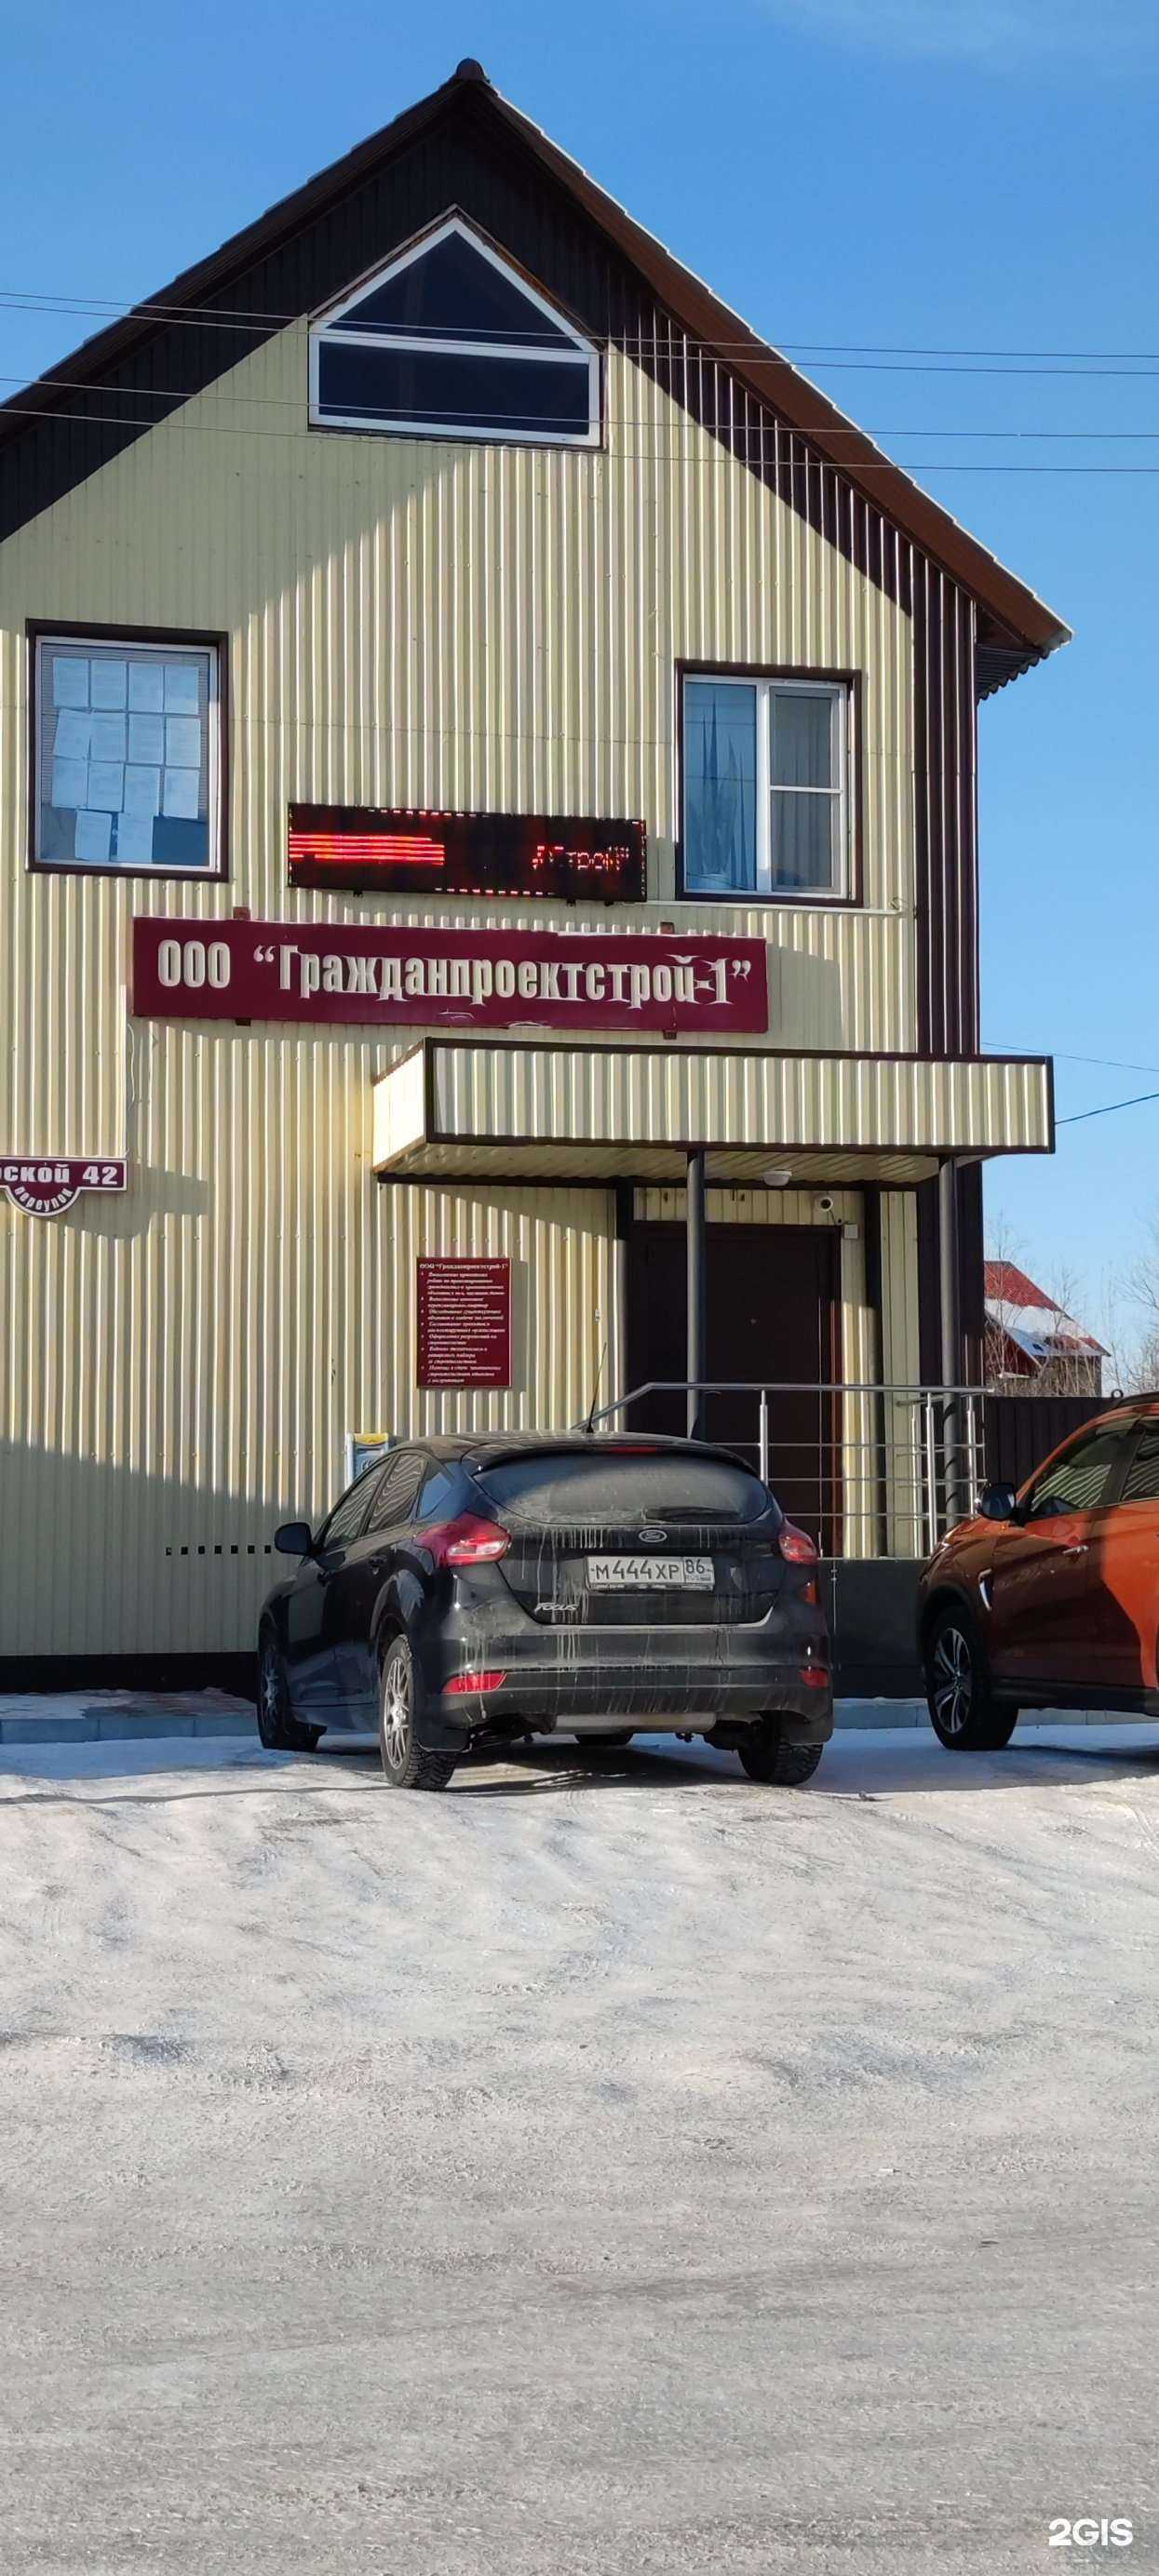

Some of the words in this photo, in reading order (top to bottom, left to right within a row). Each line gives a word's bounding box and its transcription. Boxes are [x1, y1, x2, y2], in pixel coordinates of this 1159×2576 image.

[157, 939, 231, 988] ООО
[0, 1163, 70, 1184] ской
[82, 1165, 118, 1185] 42
[685, 1559, 705, 1575] 86
